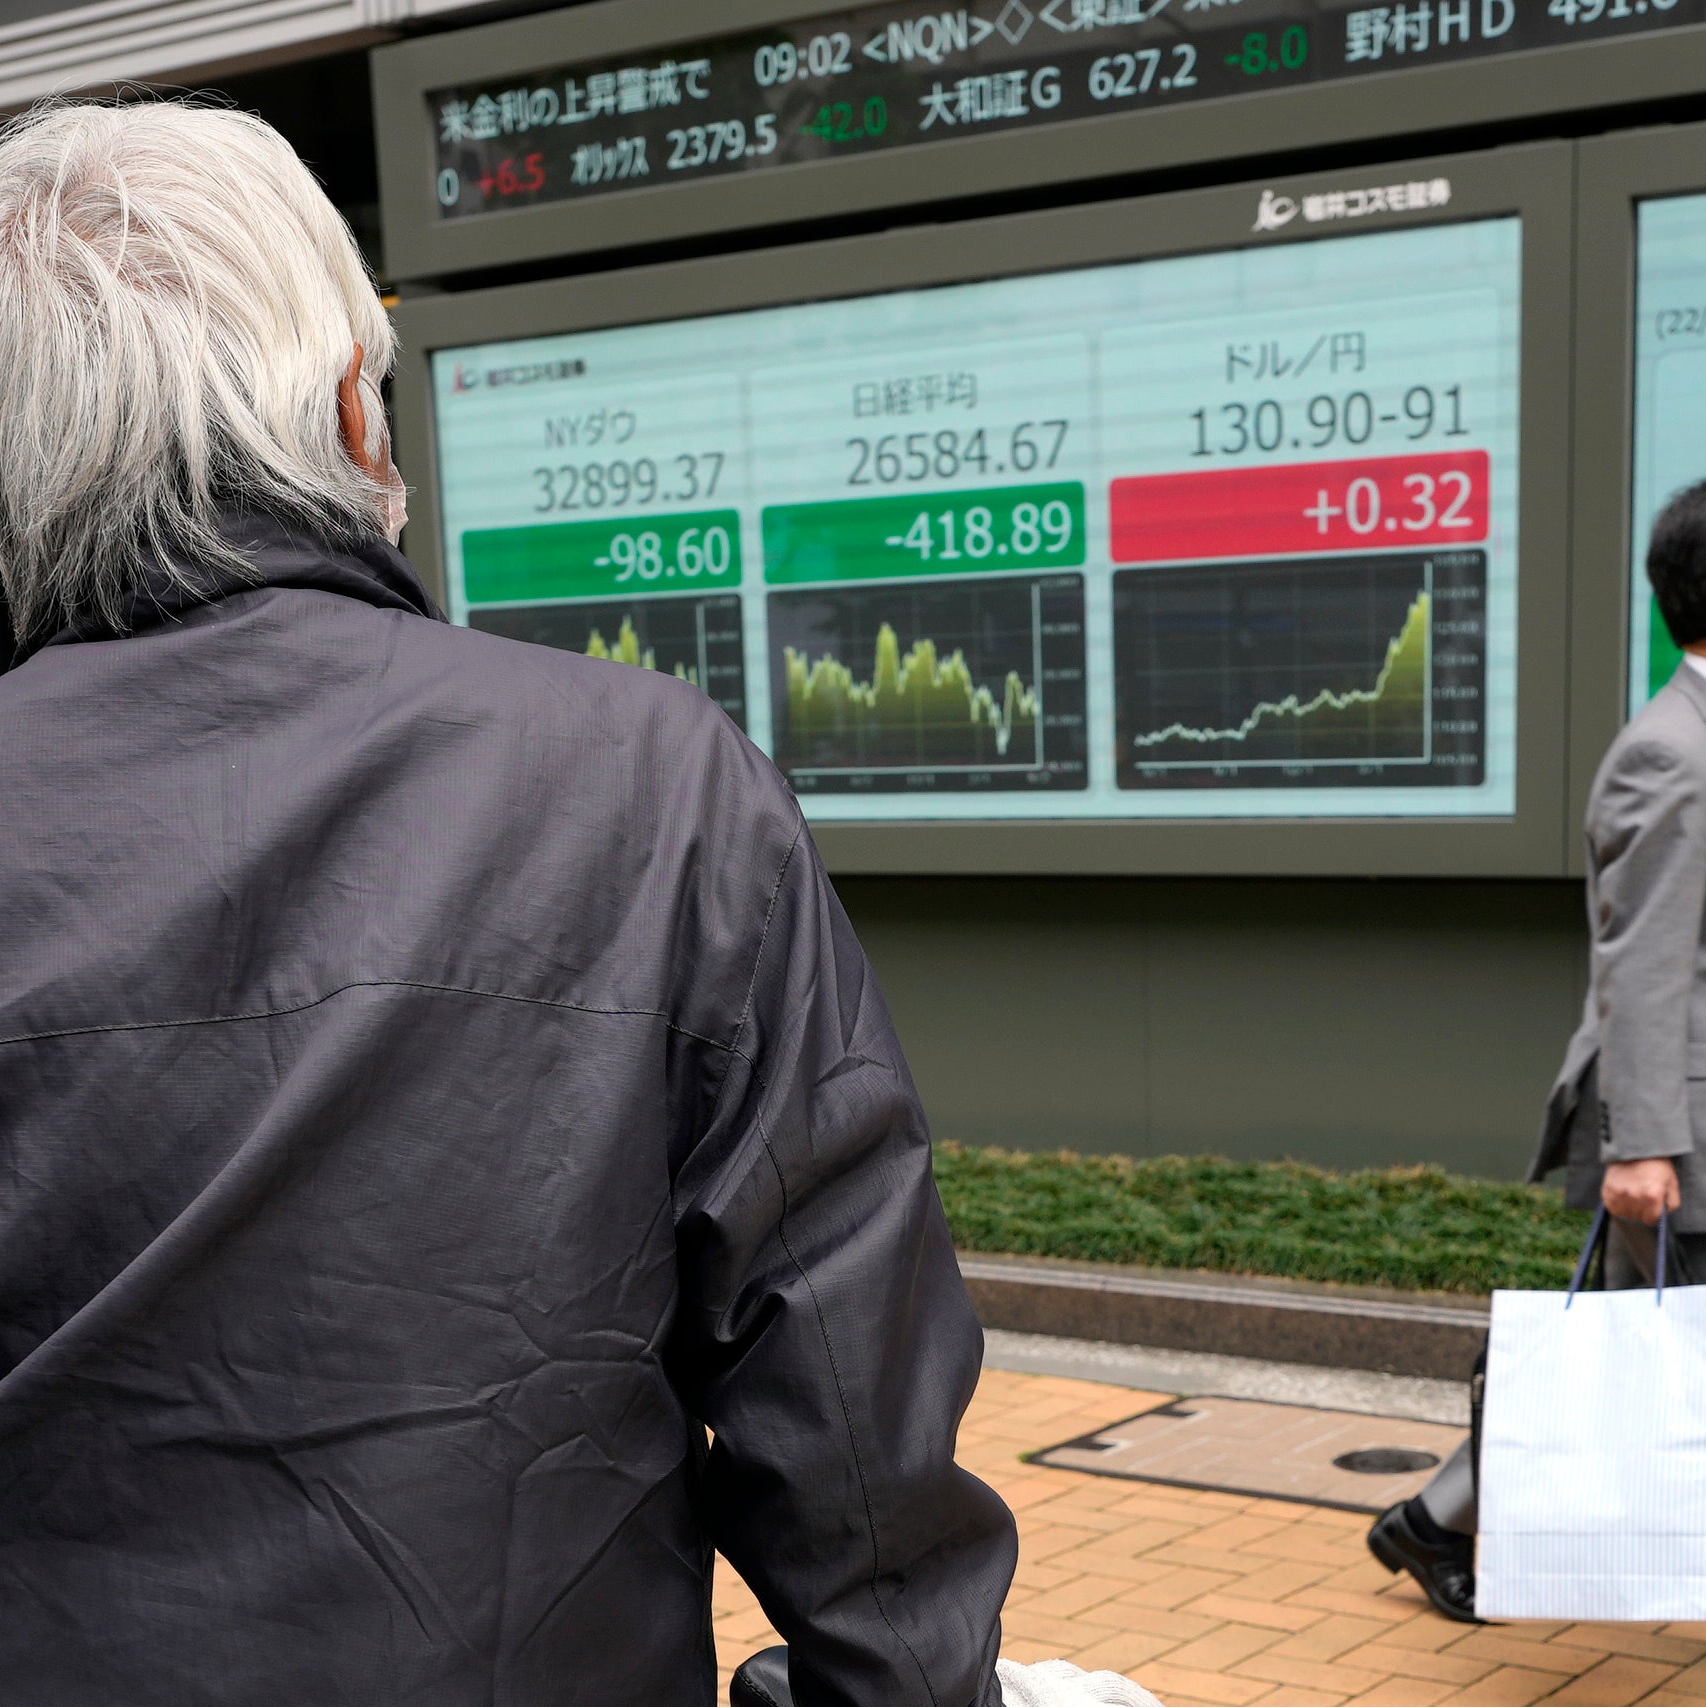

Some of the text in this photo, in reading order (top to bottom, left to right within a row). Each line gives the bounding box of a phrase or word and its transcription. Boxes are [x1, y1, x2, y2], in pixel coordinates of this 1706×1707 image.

[437, 167, 460, 206] 0
[477, 152, 545, 196] +6.5
[666, 112, 778, 170] 2379.5
[799, 95, 889, 143] -42.0
[1088, 43, 1198, 100] 627.2
[1224, 25, 1309, 76] -8.0
[1547, 0, 1681, 25] 49.
[440, 60, 711, 143] 米金利の上昇警戒で
[753, 32, 853, 87] 09:02
[852, 371, 979, 420] 日経平均
[1188, 384, 1471, 458] 130.90-91
[543, 406, 637, 449] NYダウ
[845, 419, 1069, 487] 26584.67
[532, 451, 727, 514] 32899.37
[1303, 470, 1474, 534] +0.32
[594, 525, 731, 583] -98.60
[885, 499, 1074, 560] -418.89
